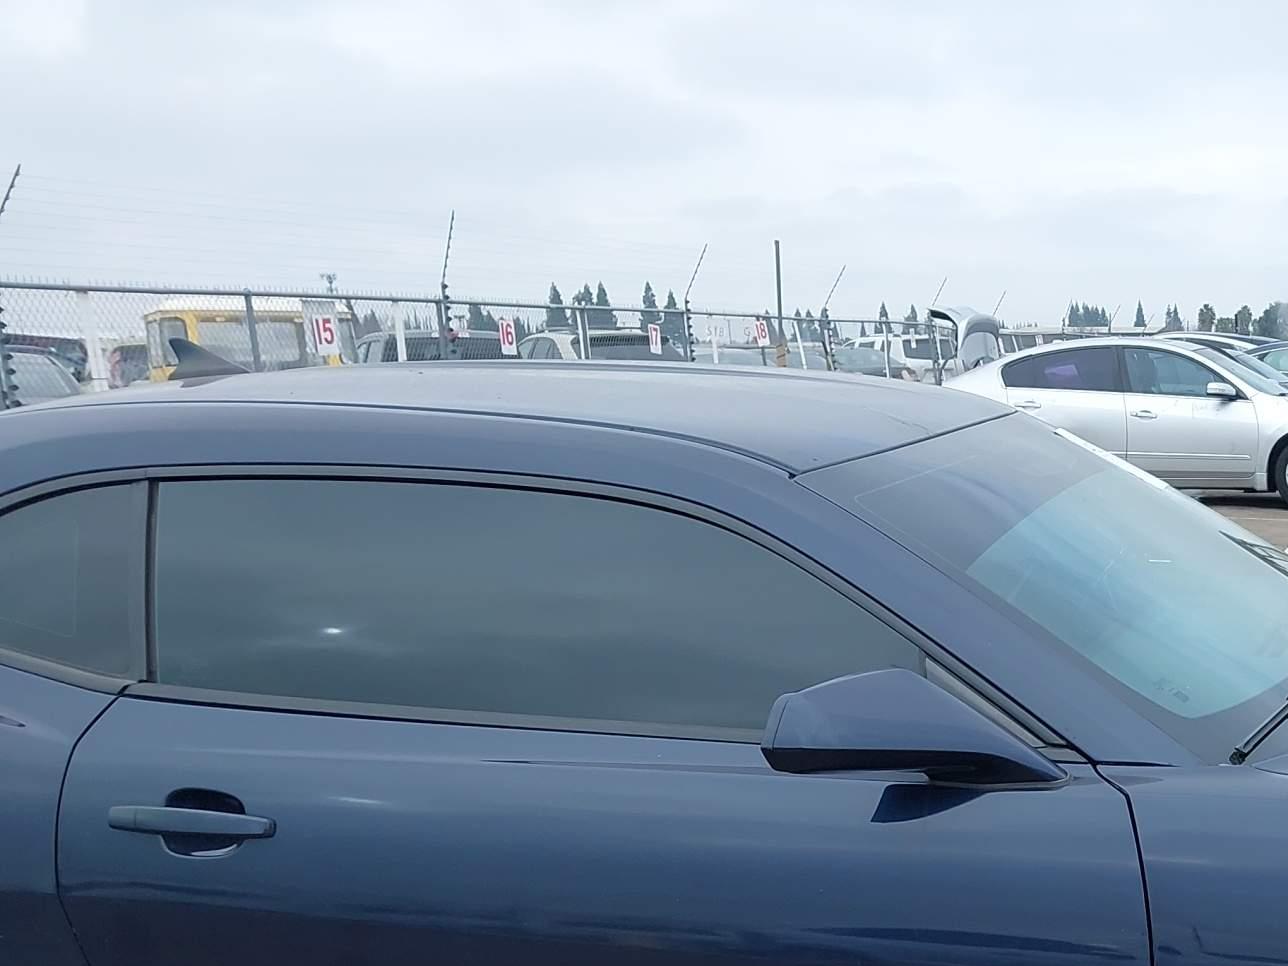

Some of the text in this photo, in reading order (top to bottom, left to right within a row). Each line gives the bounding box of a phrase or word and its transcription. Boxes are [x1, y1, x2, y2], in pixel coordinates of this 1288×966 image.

[315, 318, 335, 345] 15
[500, 322, 514, 346] 16
[649, 326, 659, 346] 17
[755, 322, 768, 341] 18
